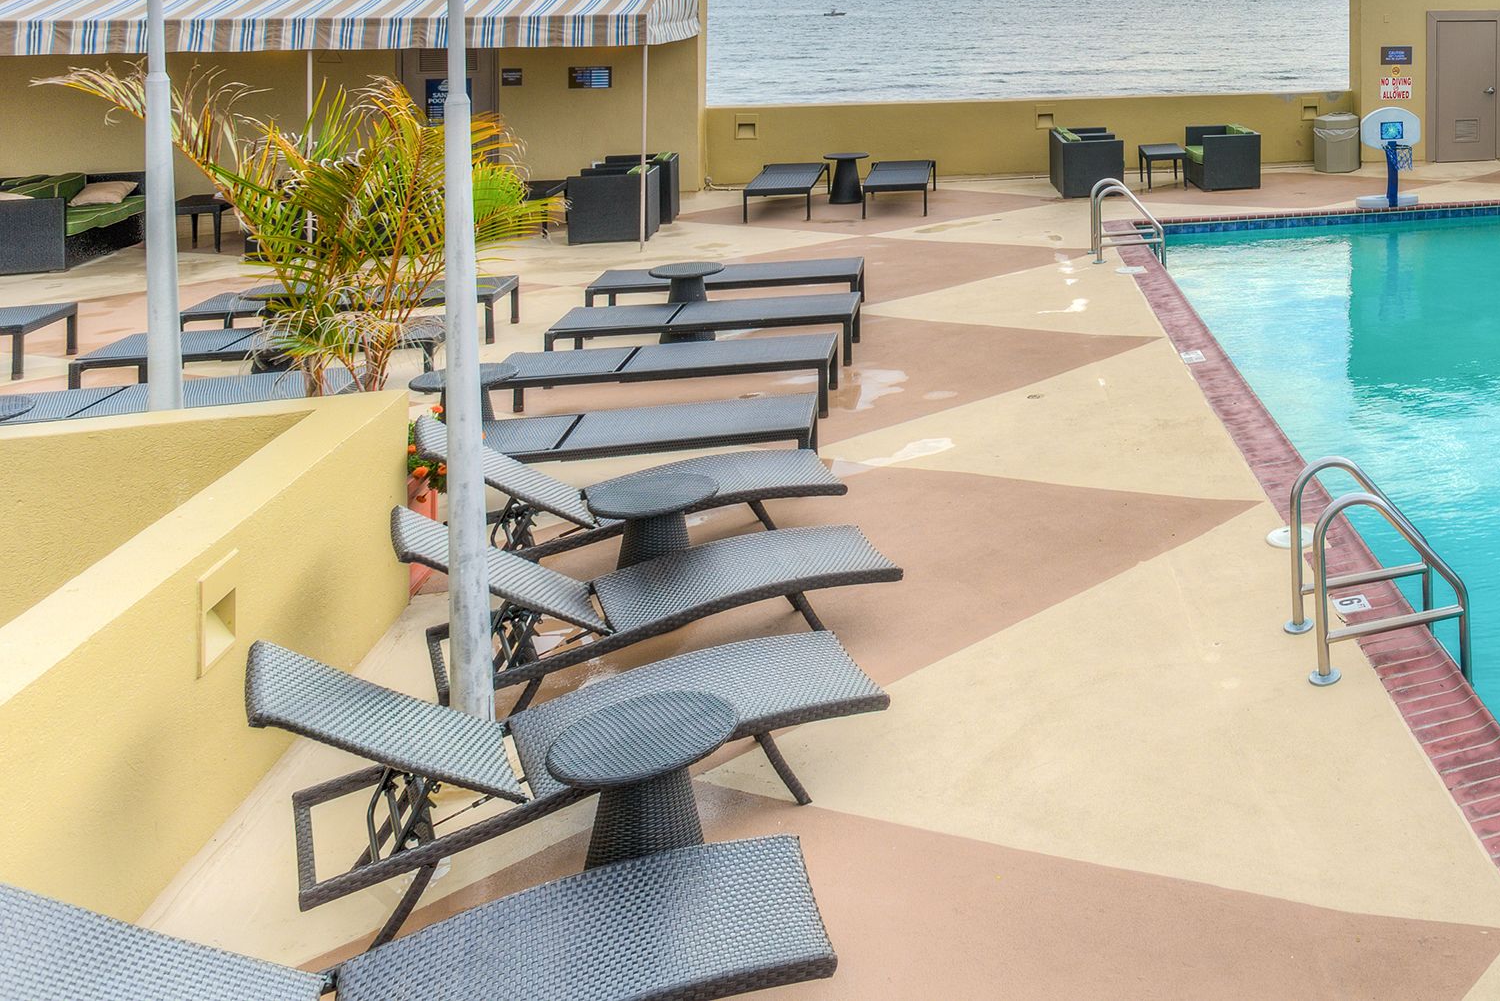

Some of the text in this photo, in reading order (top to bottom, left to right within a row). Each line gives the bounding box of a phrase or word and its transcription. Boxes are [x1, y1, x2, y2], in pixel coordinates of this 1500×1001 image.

[1381, 78, 1411, 86] NO DIVING
[1383, 91, 1409, 99] ALLOWED
[1339, 598, 1361, 606] 6
